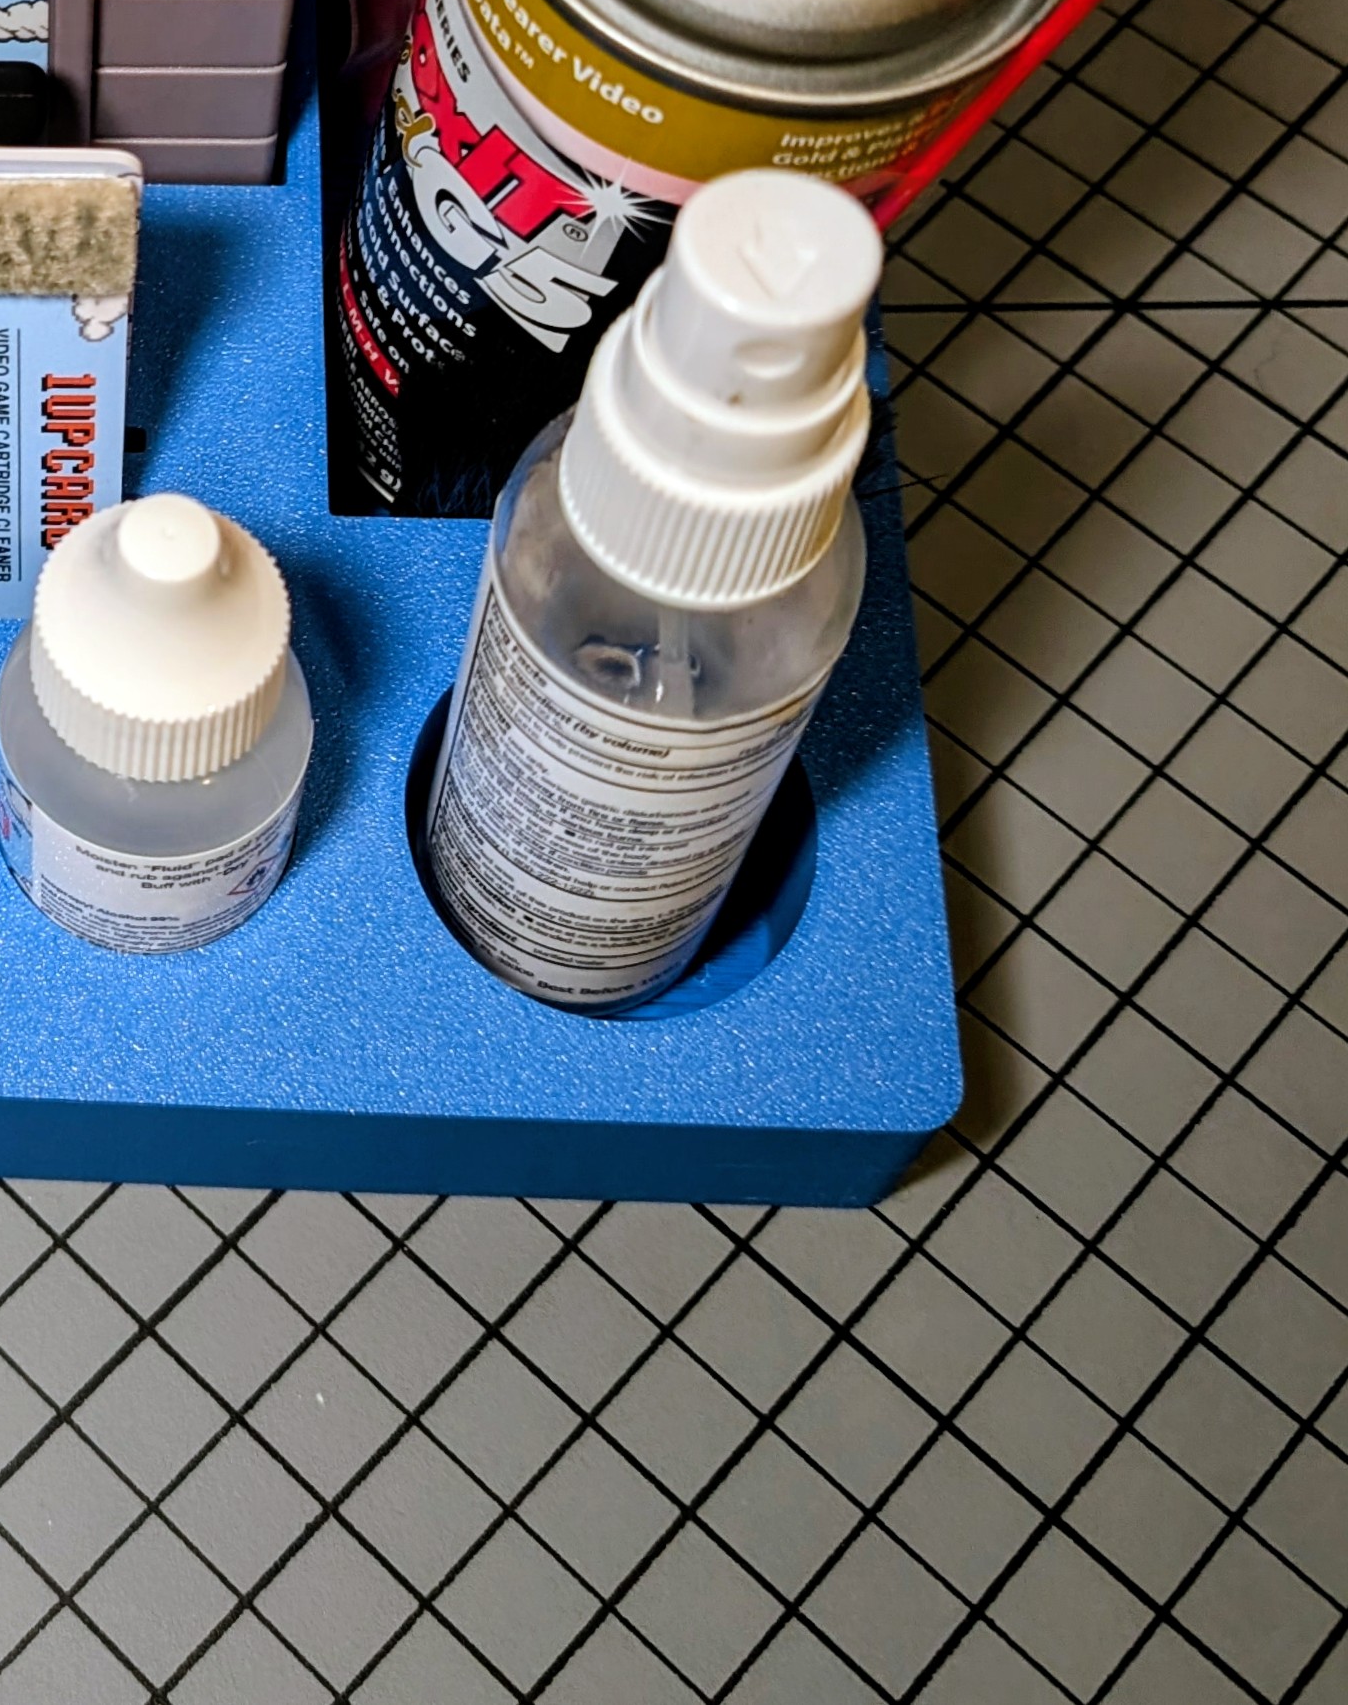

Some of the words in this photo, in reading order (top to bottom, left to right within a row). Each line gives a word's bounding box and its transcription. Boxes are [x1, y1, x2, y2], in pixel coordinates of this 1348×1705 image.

[571, 55, 665, 125] Video
[374, 176, 478, 338] Connections
[387, 175, 472, 306] Enhances
[359, 289, 388, 344] Safe
[140, 880, 176, 890] Buff
[536, 979, 576, 996] Best
